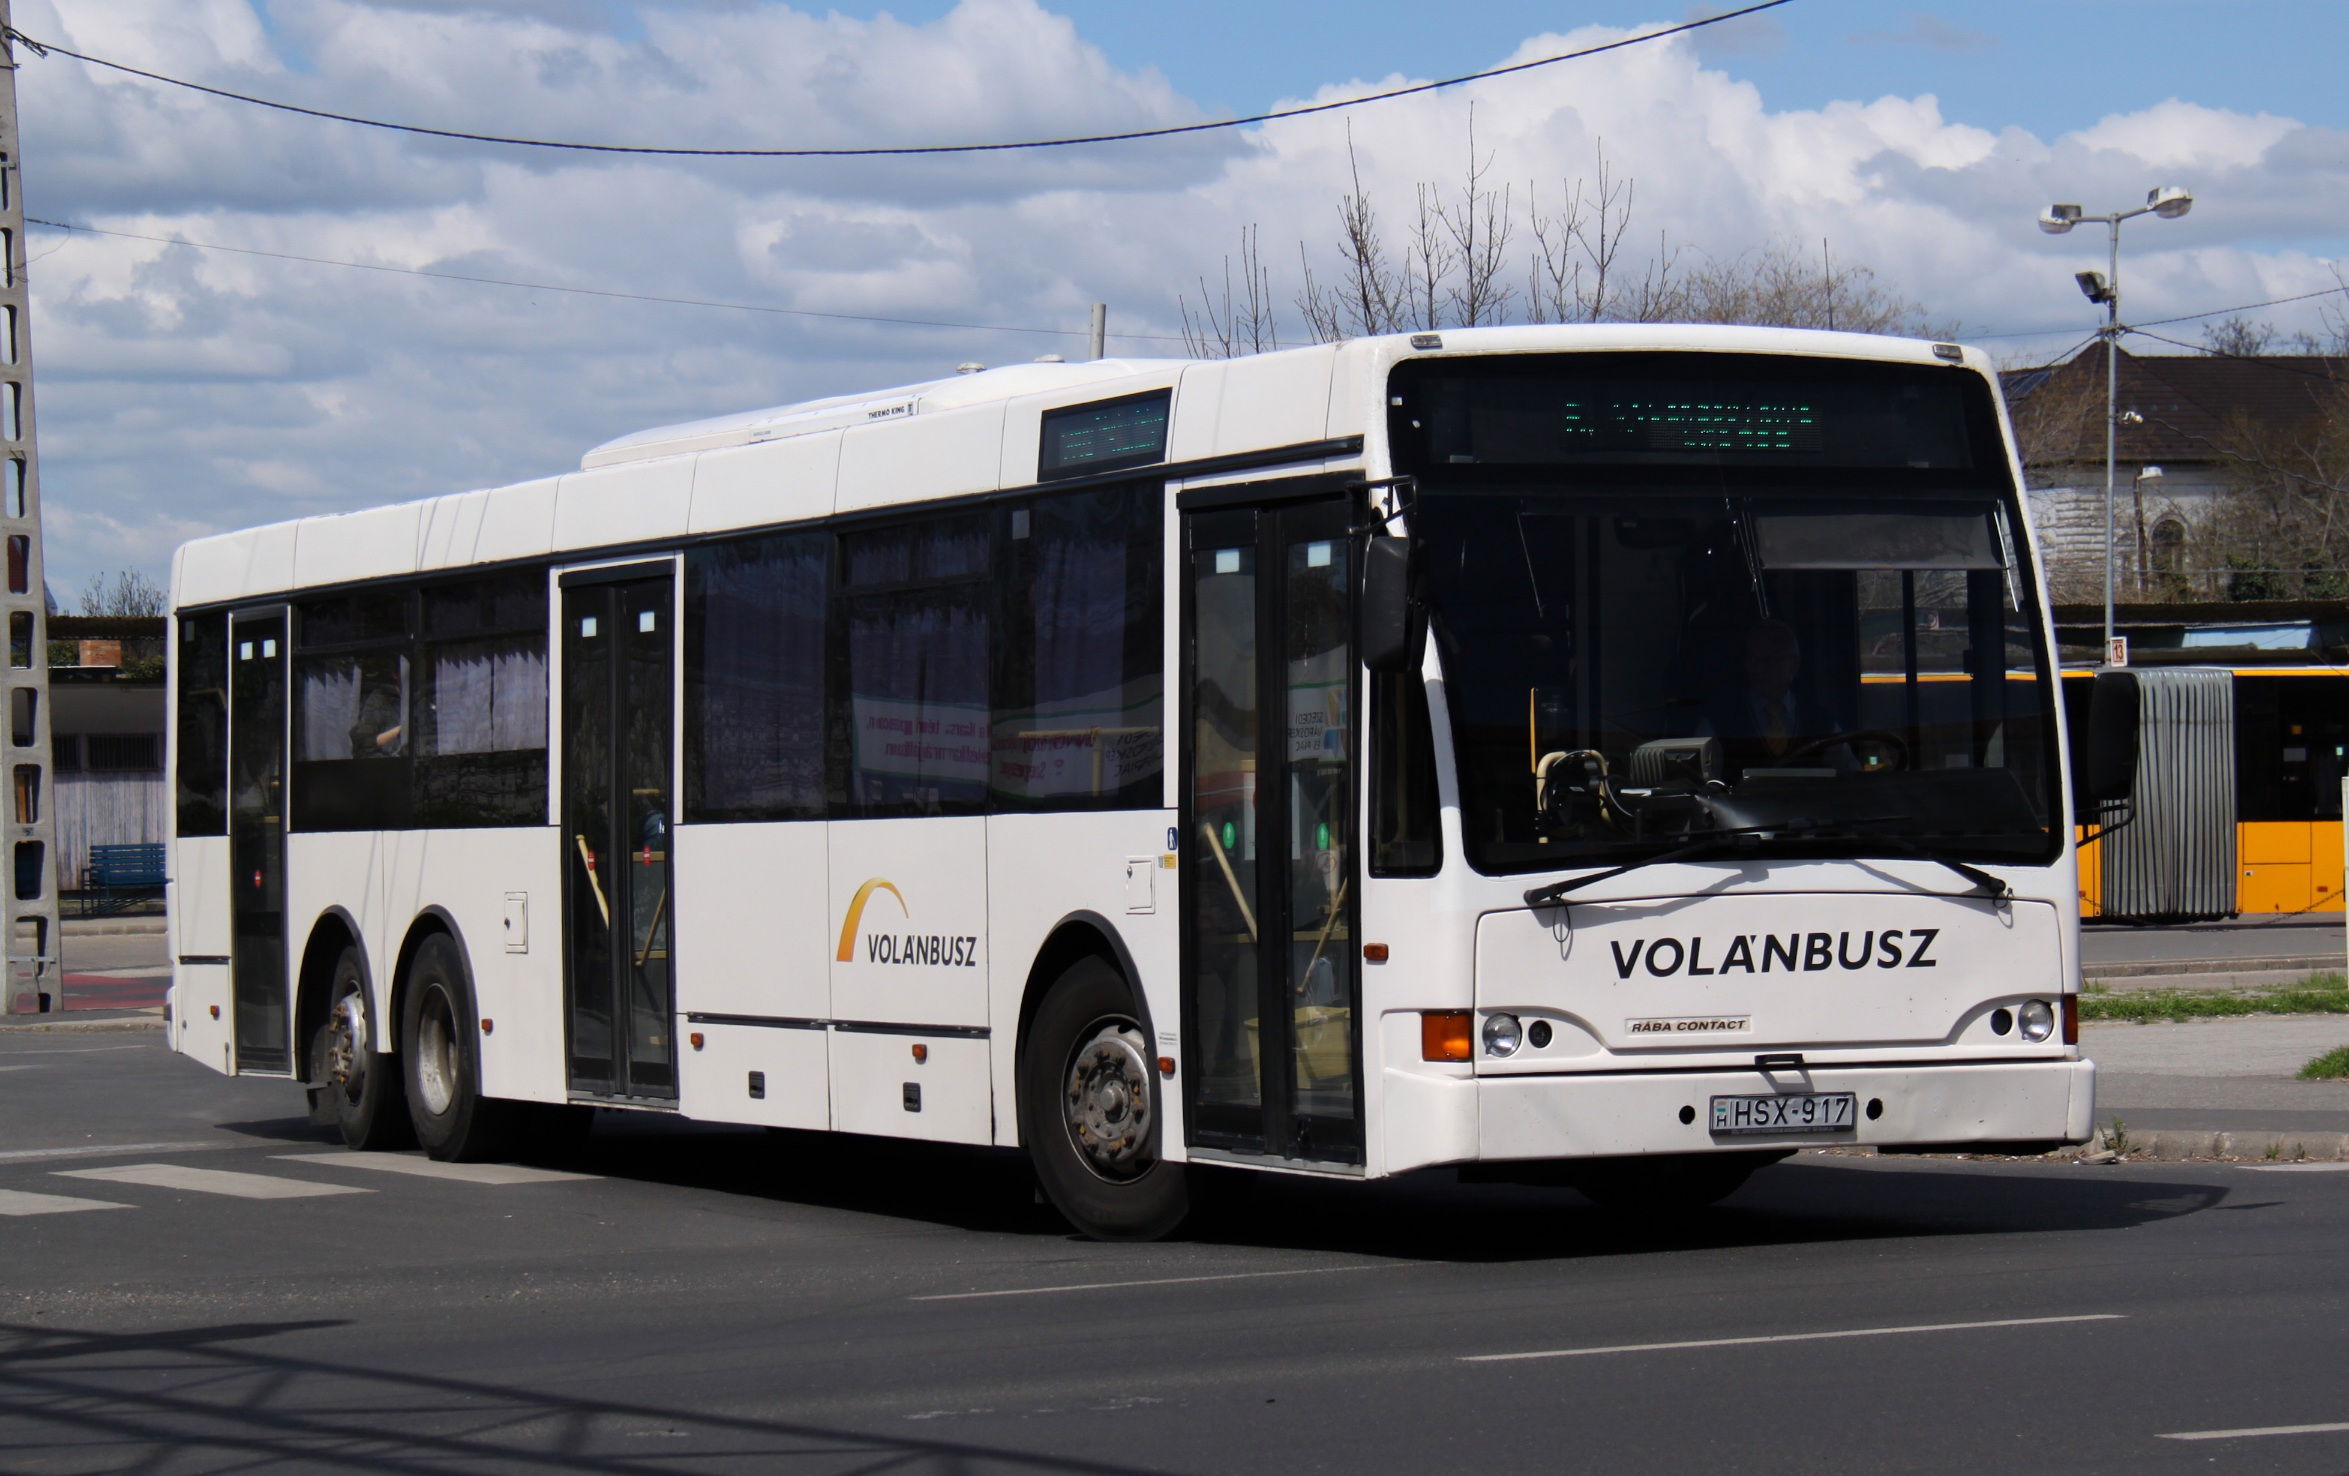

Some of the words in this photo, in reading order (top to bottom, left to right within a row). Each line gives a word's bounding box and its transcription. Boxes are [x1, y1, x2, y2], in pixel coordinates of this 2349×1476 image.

[868, 409, 890, 419] THERMO
[891, 406, 905, 415] KING
[2114, 644, 2124, 660] 13
[868, 934, 977, 967] VOLÁNBUSZ
[1610, 929, 1940, 979] VOLÁNBUSZ
[1631, 1021, 1672, 1033] RÁBA
[1677, 1020, 1746, 1031] CONTACT
[1716, 1115, 1727, 1127] H
[1735, 1098, 1849, 1127] HSX-917
